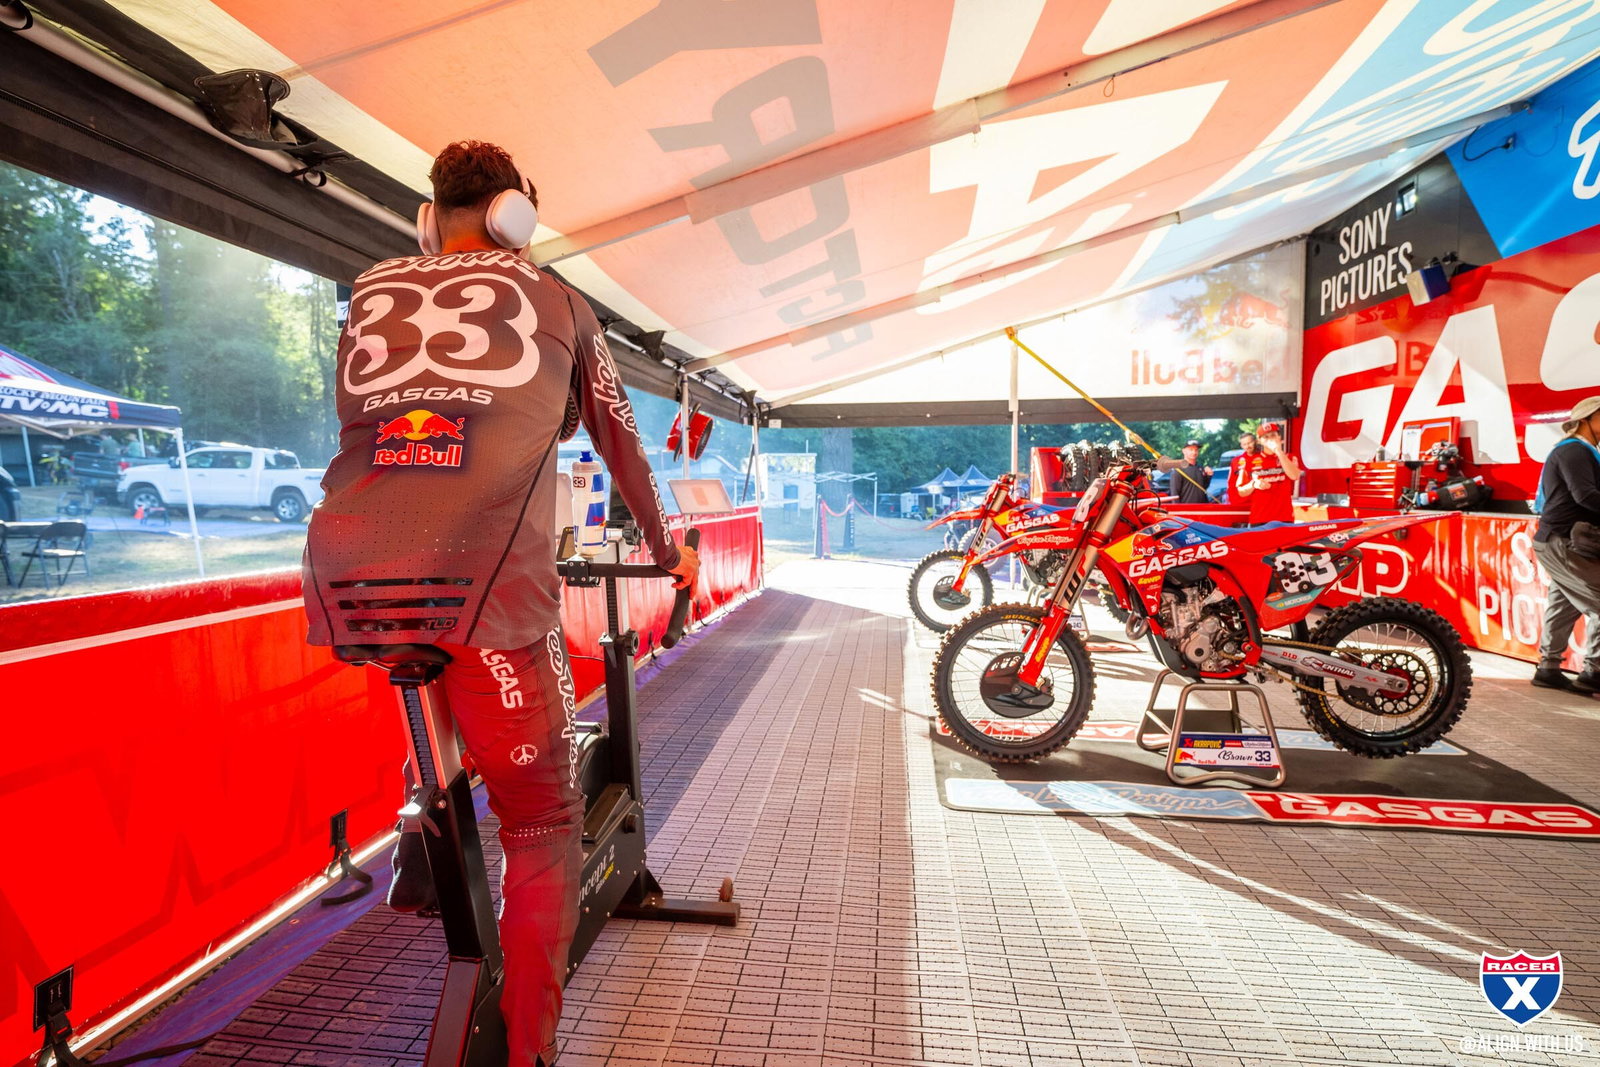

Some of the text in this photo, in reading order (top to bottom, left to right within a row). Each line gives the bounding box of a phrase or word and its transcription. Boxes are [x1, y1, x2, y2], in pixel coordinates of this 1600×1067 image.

[1339, 202, 1392, 265] SONY
[1320, 241, 1413, 316] PICTURES
[344, 275, 540, 396] 33
[363, 387, 494, 414] GASGAS
[413, 443, 462, 467] Bull
[571, 476, 586, 488] 33
[1005, 514, 1060, 533] GASGAS
[1128, 541, 1229, 577] GASGAS
[426, 619, 455, 629] TLD
[1218, 750, 1272, 762] Brown 33
[1280, 799, 1594, 828] GASGAS
